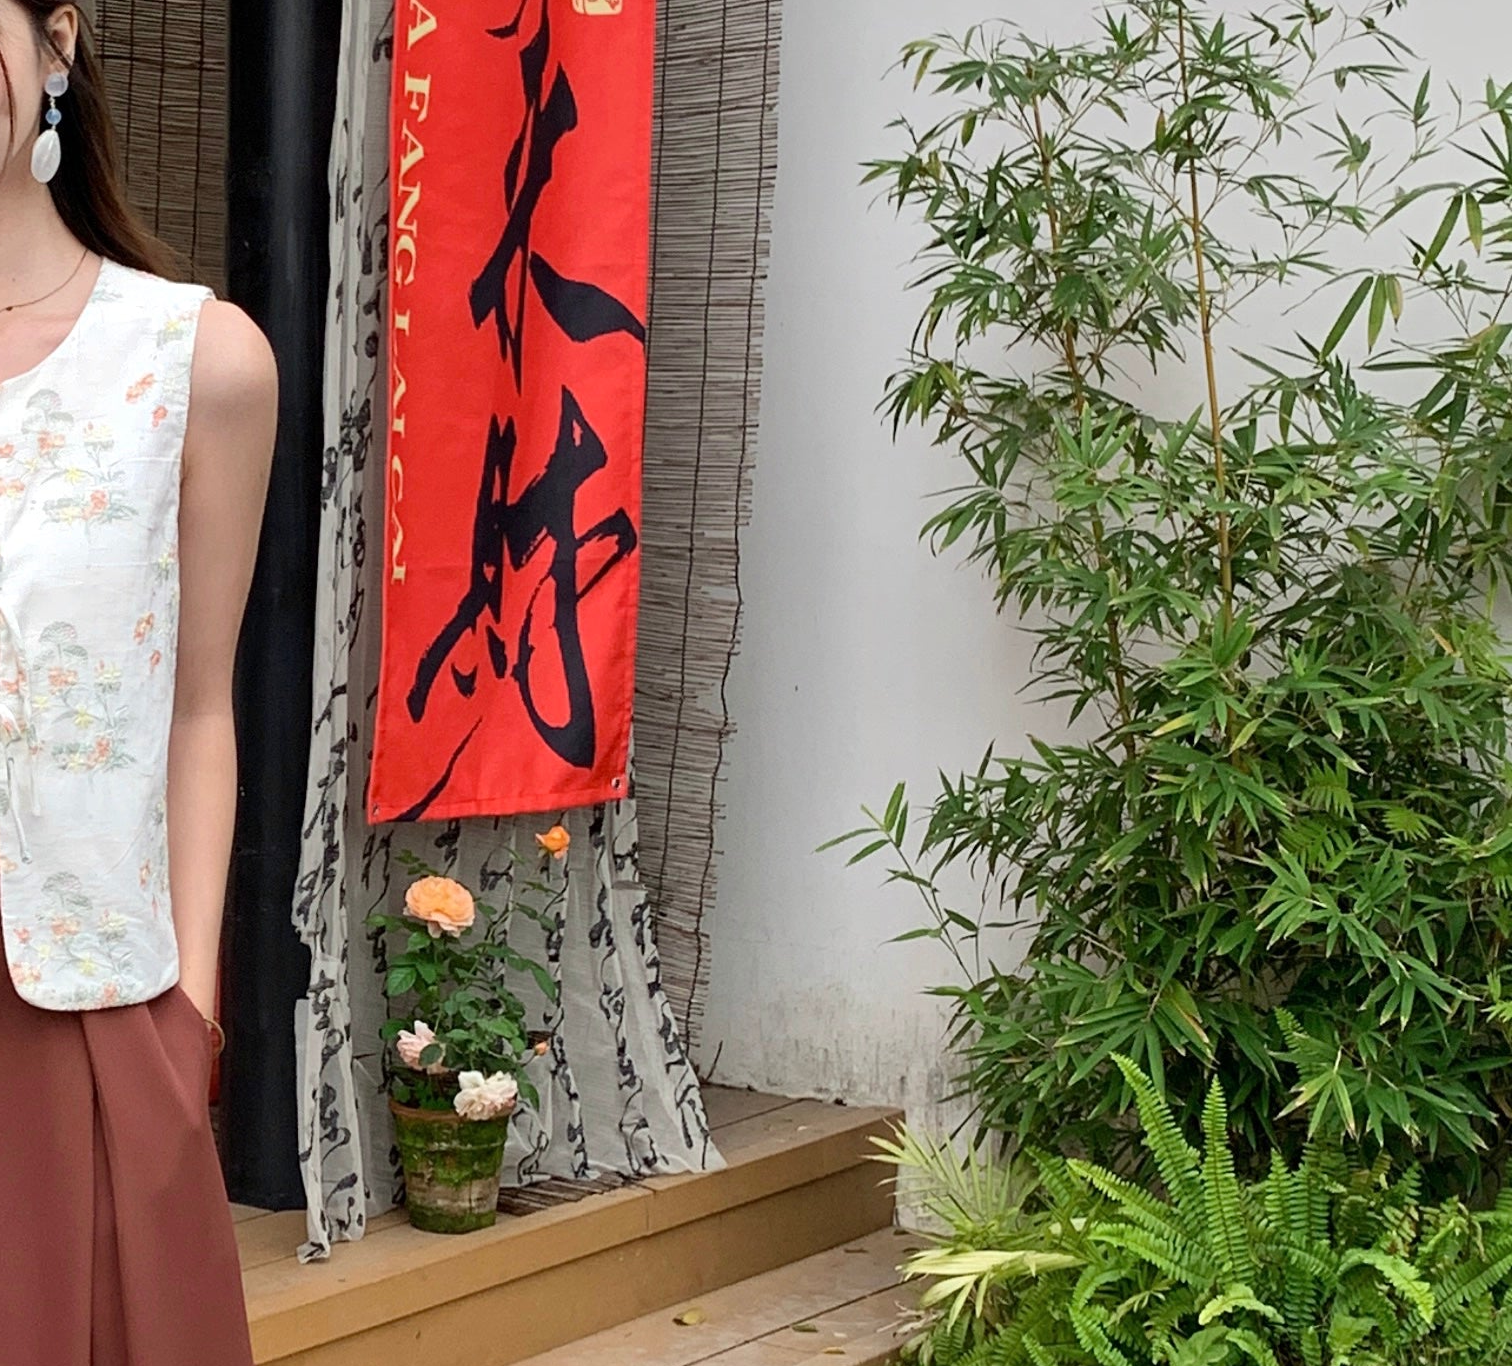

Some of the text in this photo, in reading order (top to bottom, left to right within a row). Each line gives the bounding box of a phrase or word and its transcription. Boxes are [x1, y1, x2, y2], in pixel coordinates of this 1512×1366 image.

[395, 70, 431, 289] FANG
[393, 308, 410, 438] LAI
[391, 454, 406, 584] CAI
